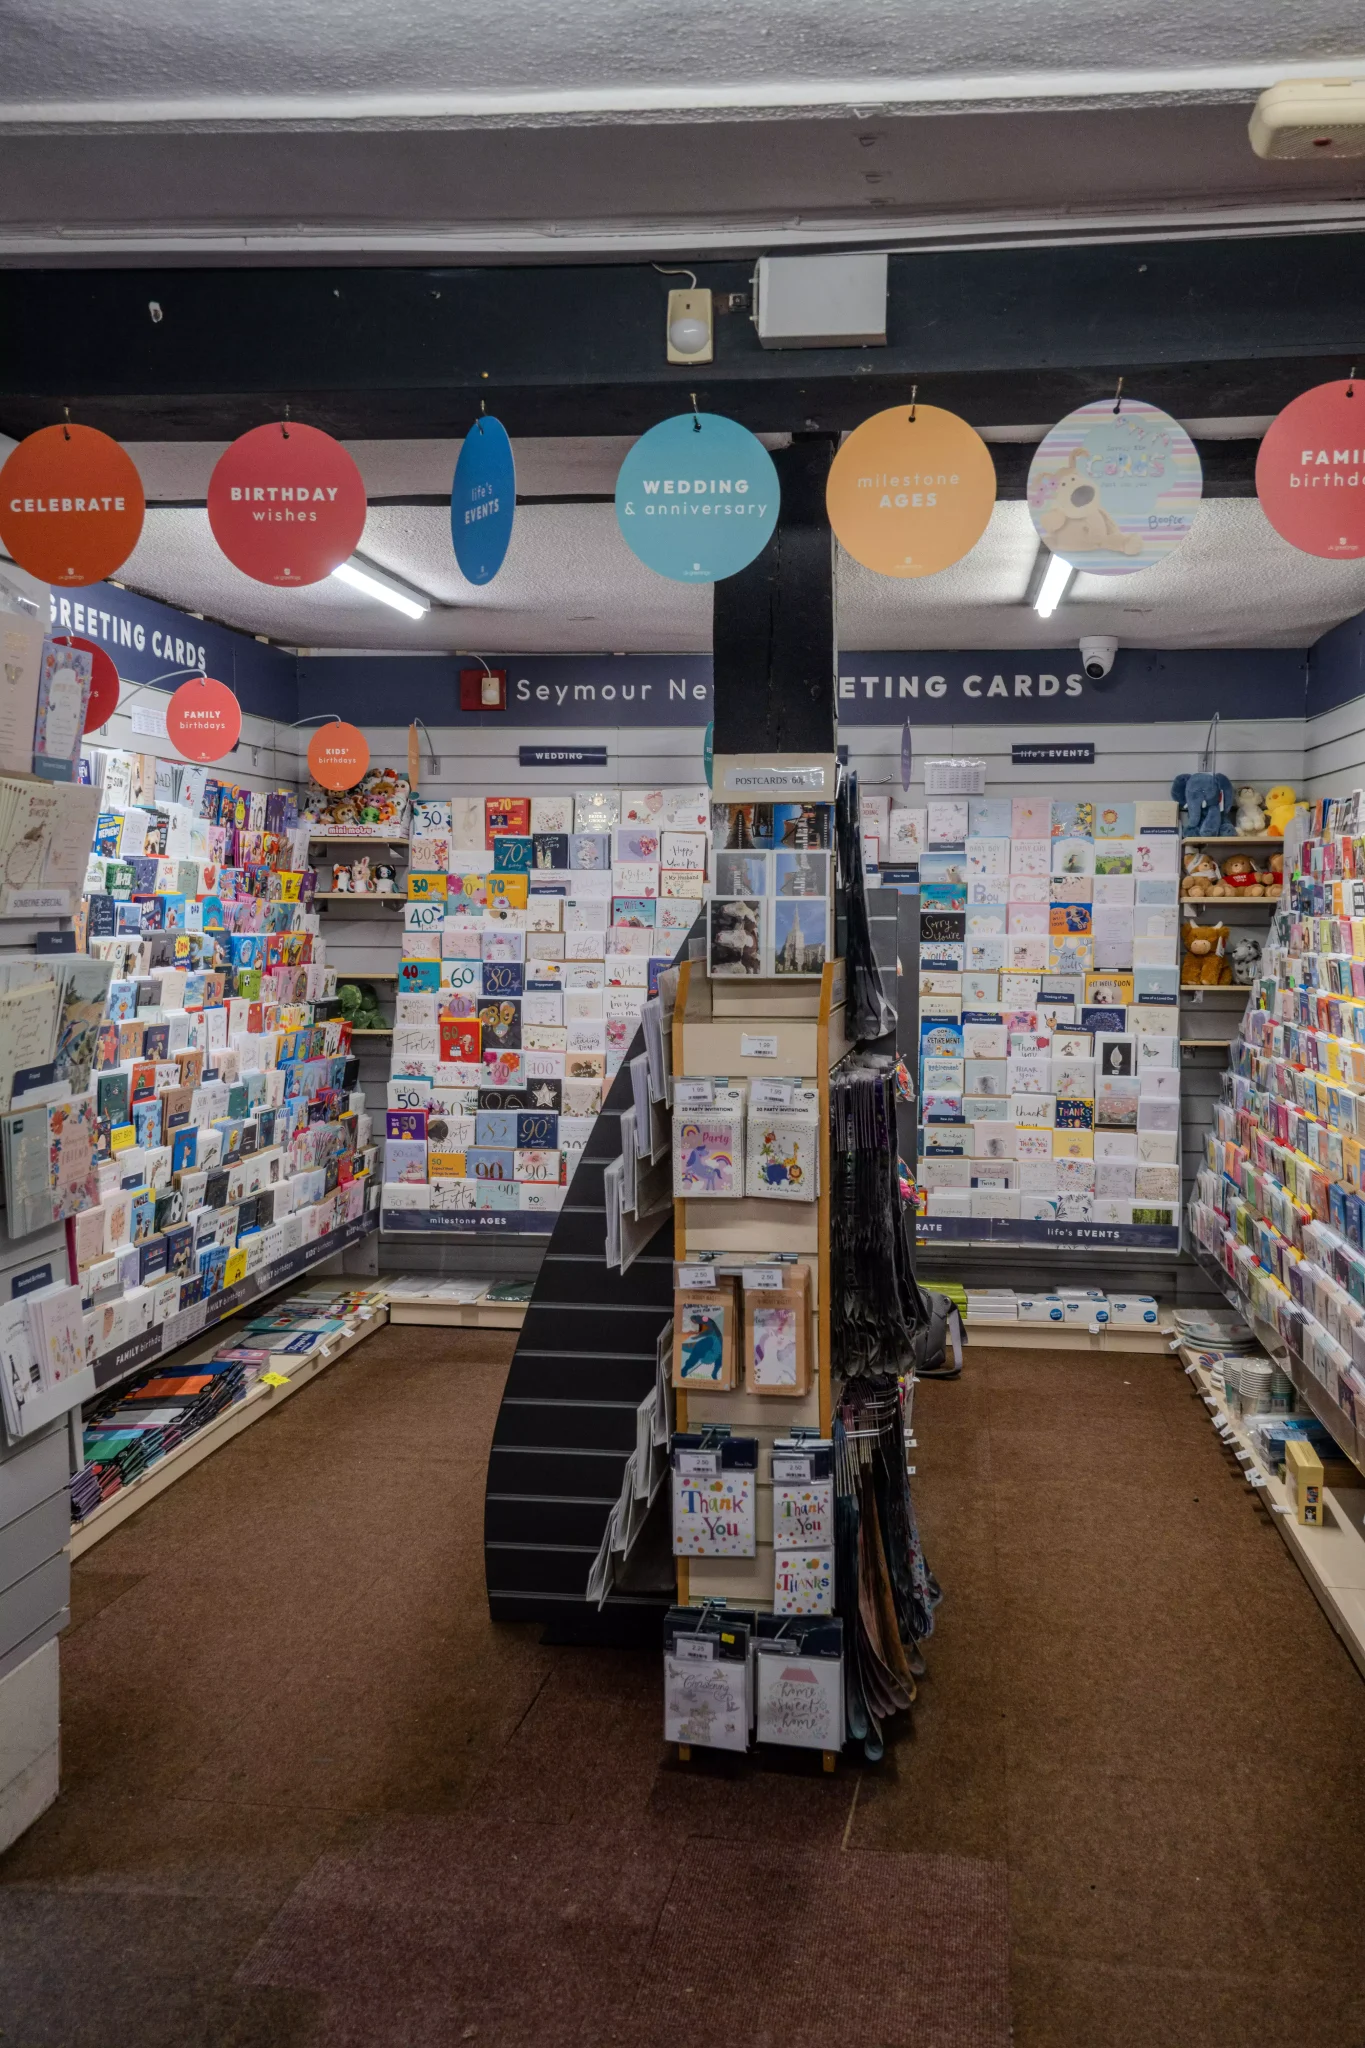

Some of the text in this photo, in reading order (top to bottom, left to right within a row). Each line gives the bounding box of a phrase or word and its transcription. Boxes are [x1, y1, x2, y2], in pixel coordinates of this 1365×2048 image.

[1301, 449, 1365, 466] FAMI
[642, 479, 750, 495] WEDDING
[857, 472, 960, 488] milestone
[230, 486, 339, 502] BIRTHDAY
[471, 483, 493, 502] life's
[879, 492, 938, 509] AGES
[10, 497, 126, 513] CELEBRATE
[464, 498, 499, 526] EVENTS
[624, 501, 768, 518] & anniversary
[252, 507, 318, 522] wishes
[152, 630, 207, 671] CARDS
[516, 679, 714, 706] Seymour Ne
[838, 673, 1084, 699] ETING CARDS
[183, 710, 221, 720] FAMILY
[179, 721, 226, 732] birthdays
[318, 756, 357, 765] birthdays
[535, 751, 584, 760] WEDDING
[1020, 749, 1090, 758] life's EVENTS
[735, 776, 788, 786] POSTCARDS
[499, 798, 511, 810] 70
[421, 811, 442, 828] 30
[328, 826, 348, 835] mini
[416, 847, 431, 860] 30
[502, 844, 524, 867] 70
[672, 845, 694, 857] Happy
[412, 879, 429, 893] 30
[488, 879, 505, 894] 70
[38, 898, 63, 907] SPECIAL
[142, 900, 155, 914] SON
[623, 900, 638, 910] WIFE
[410, 909, 434, 928] 40
[922, 915, 951, 939] Sorry
[402, 965, 419, 979] 40
[451, 967, 474, 988] 60
[486, 968, 512, 992] 80
[485, 1005, 514, 1026] 80
[442, 1026, 459, 1041] 60
[927, 1037, 961, 1045] RETIREMENT
[1017, 1043, 1041, 1051] Thank
[493, 1067, 510, 1078] 80
[532, 1062, 554, 1075] 100
[397, 1092, 420, 1110] 50
[1015, 1106, 1043, 1117] thank
[1058, 1107, 1091, 1117] THANKS
[400, 1116, 417, 1130] 50
[521, 1119, 548, 1142] 90
[1067, 1118, 1081, 1128] SO
[702, 1132, 730, 1145] Party
[1036, 1140, 1048, 1148] YOU
[475, 1162, 503, 1179] 90
[525, 1164, 547, 1180] 90
[498, 1184, 514, 1196] 90
[980, 1179, 996, 1187] Twins
[528, 1196, 540, 1204] 90
[430, 1217, 507, 1225] milestone AGES
[226, 1225, 236, 1236] SON
[1047, 1228, 1120, 1238] life's EVENTS
[305, 1240, 334, 1259] KIDS' birthdays
[257, 1270, 273, 1286] FAMILY
[274, 1260, 294, 1278] birthdays
[206, 1287, 246, 1313] AMILY birthdays
[115, 1345, 139, 1366] FAMILY
[681, 1490, 744, 1514] Thank
[781, 1500, 825, 1517] Thank
[703, 1517, 739, 1540] You
[797, 1518, 822, 1535] You
[683, 1672, 730, 1699] Christening
[781, 1681, 816, 1699] home
[777, 1697, 820, 1713] sweet
[781, 1714, 817, 1730] home
